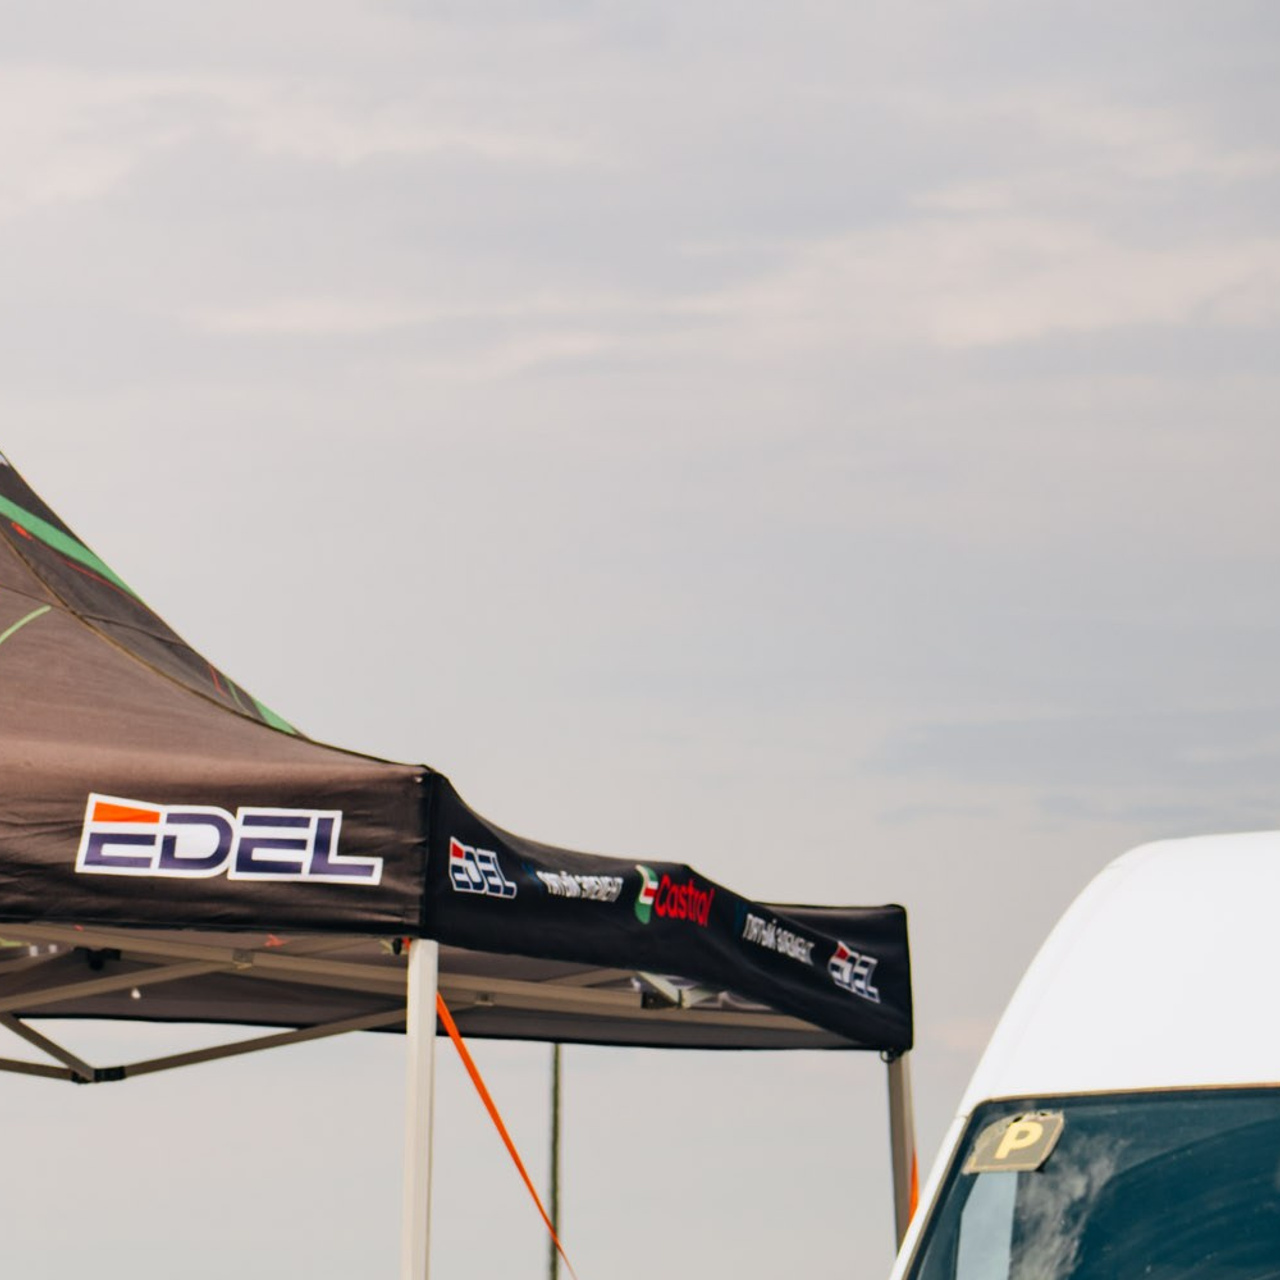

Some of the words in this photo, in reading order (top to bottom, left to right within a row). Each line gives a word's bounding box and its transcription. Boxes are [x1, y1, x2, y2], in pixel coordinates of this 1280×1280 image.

[76, 794, 382, 884] EDEL
[449, 836, 517, 899] EDEL
[655, 873, 715, 927] Castrol
[994, 1121, 1043, 1160] P
